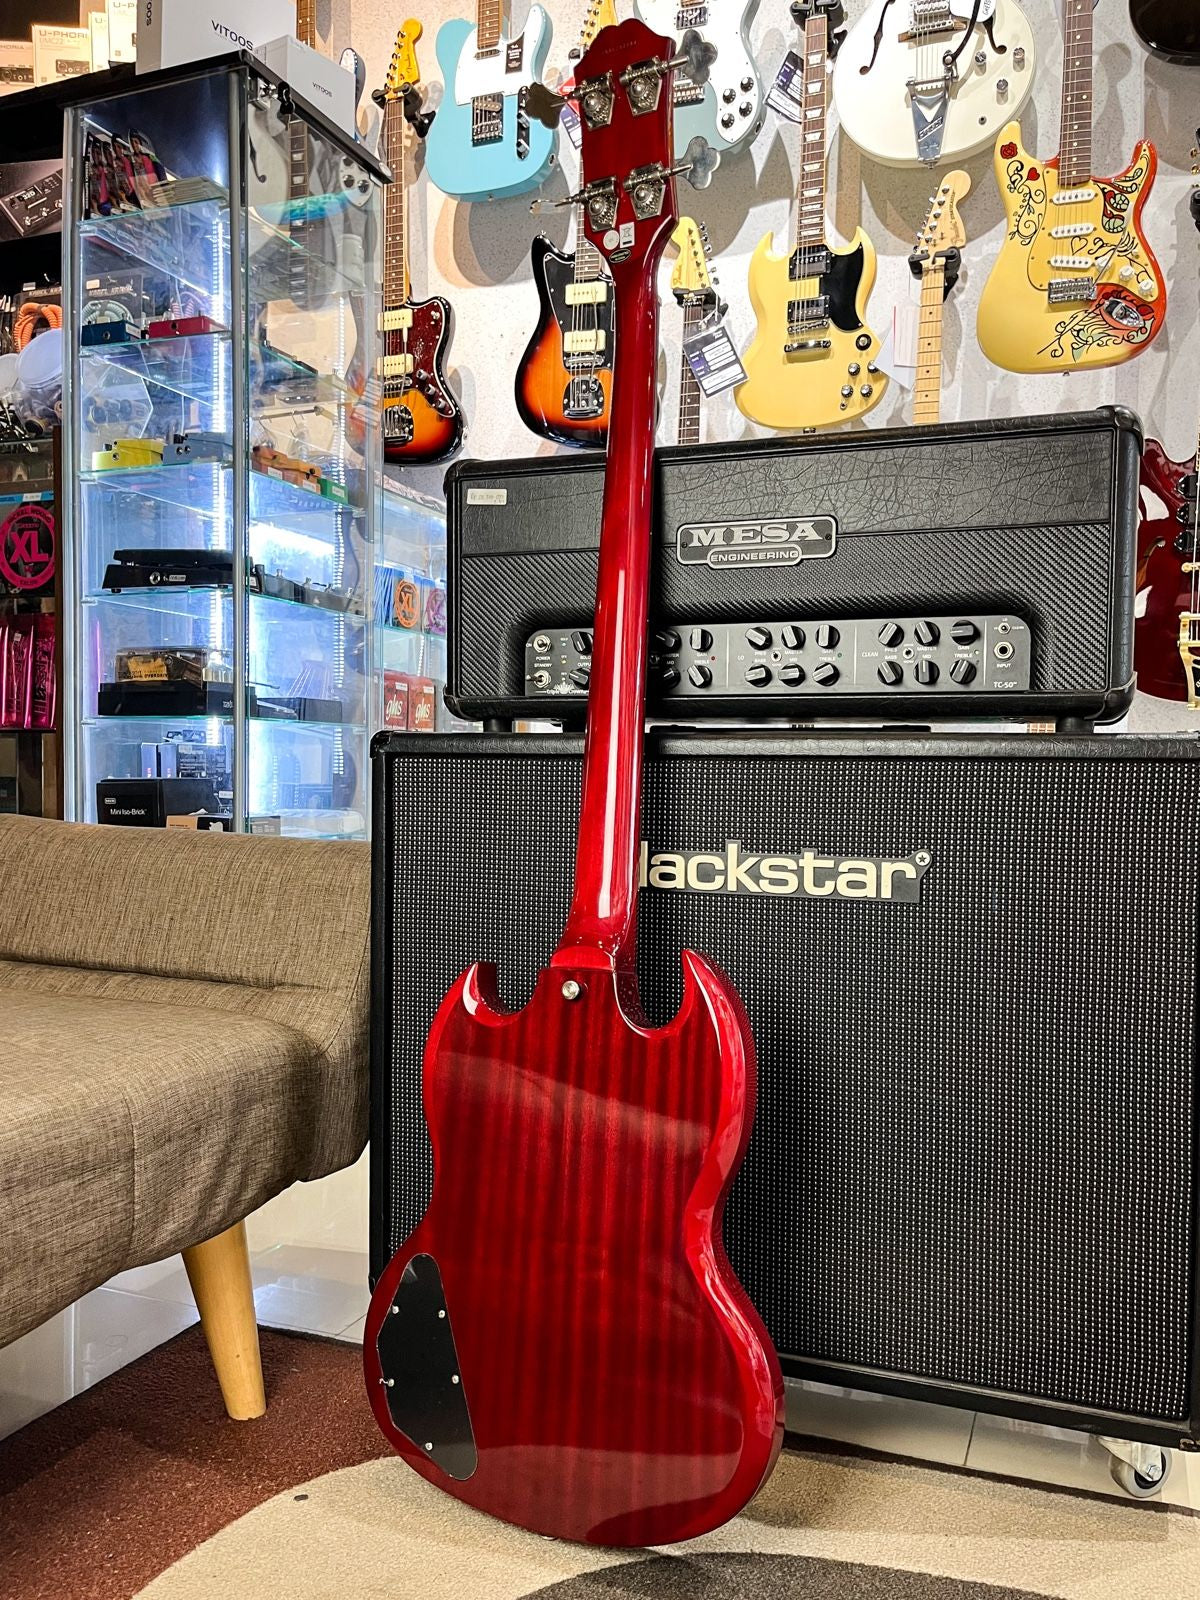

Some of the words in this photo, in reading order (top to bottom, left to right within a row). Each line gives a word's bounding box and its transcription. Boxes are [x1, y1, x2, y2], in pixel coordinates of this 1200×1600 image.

[211, 20, 254, 50] VITOOS
[312, 81, 333, 98] VITOOS
[10, 530, 49, 563] XL
[688, 522, 823, 547] MESA
[710, 550, 799, 562] ENGINEERING
[400, 591, 414, 612] XL
[385, 694, 403, 721] ghs
[415, 698, 431, 724] ghs
[110, 808, 122, 816] Mini
[639, 840, 917, 899] lackstar
